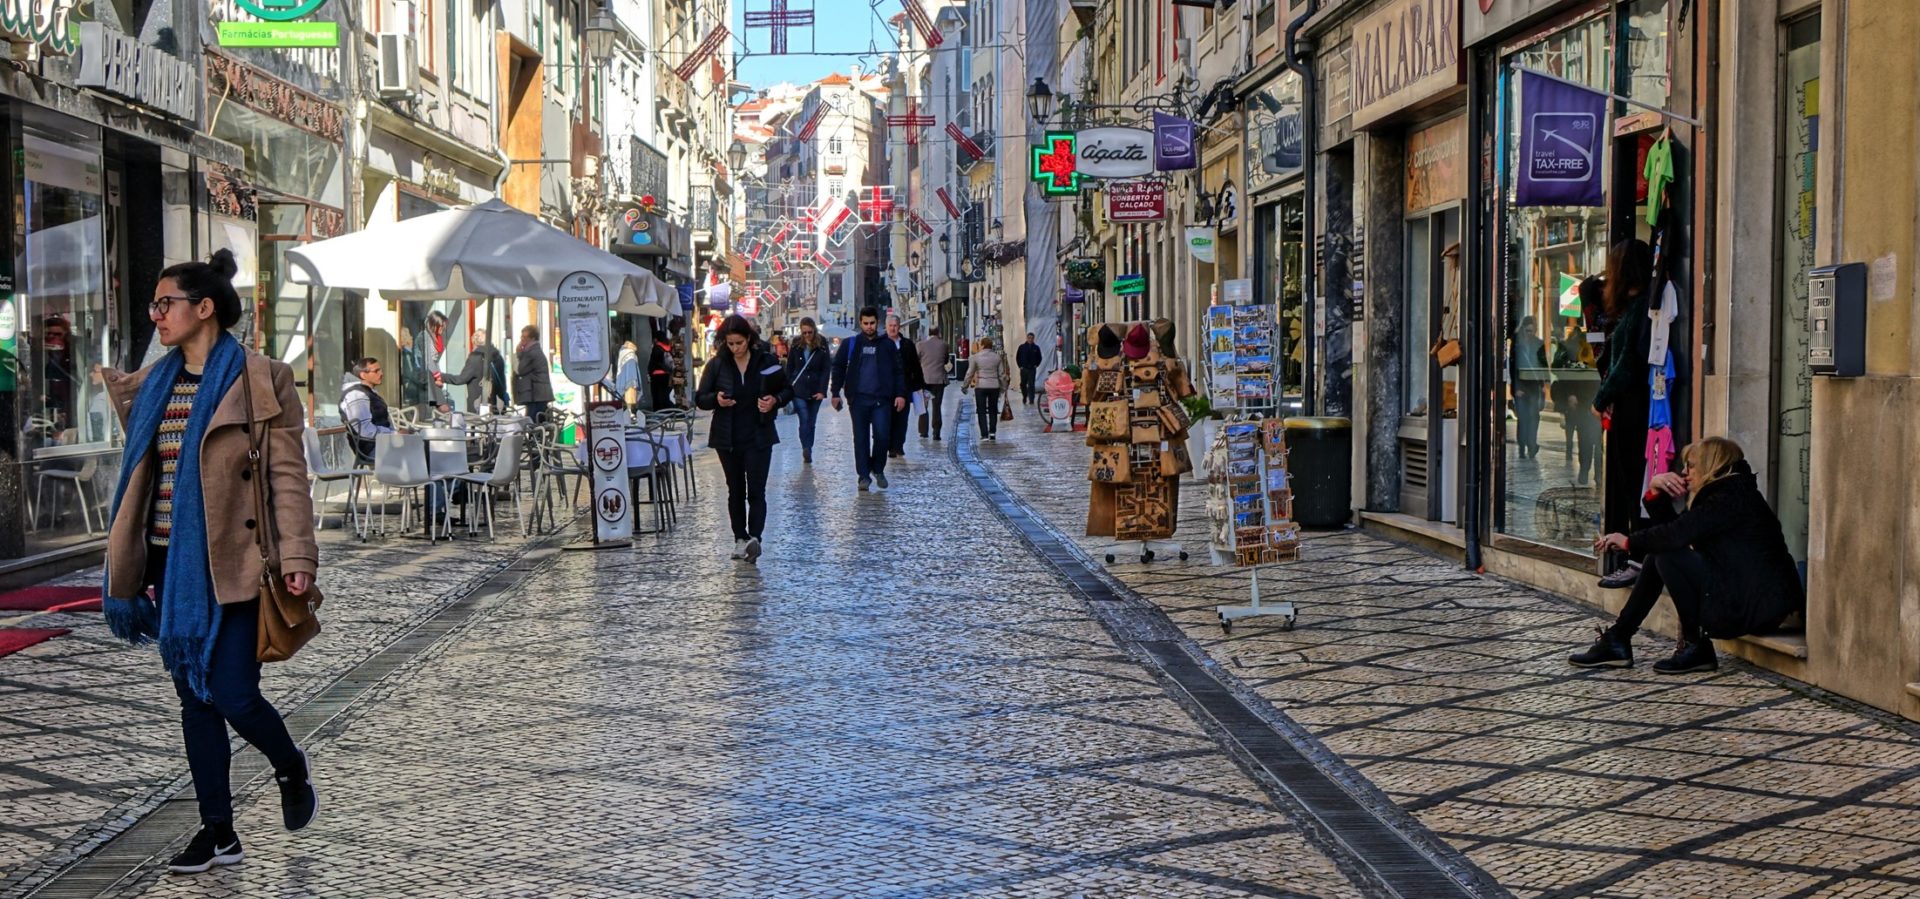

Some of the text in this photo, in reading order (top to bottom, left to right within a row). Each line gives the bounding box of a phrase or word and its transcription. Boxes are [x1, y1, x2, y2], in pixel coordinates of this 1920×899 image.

[1354, 0, 1457, 111] MALABAR
[1535, 149, 1555, 157] travel
[1534, 158, 1584, 169] TAX-FREE
[1111, 194, 1150, 202] CONSERTO
[1119, 201, 1154, 209] CALÇADO
